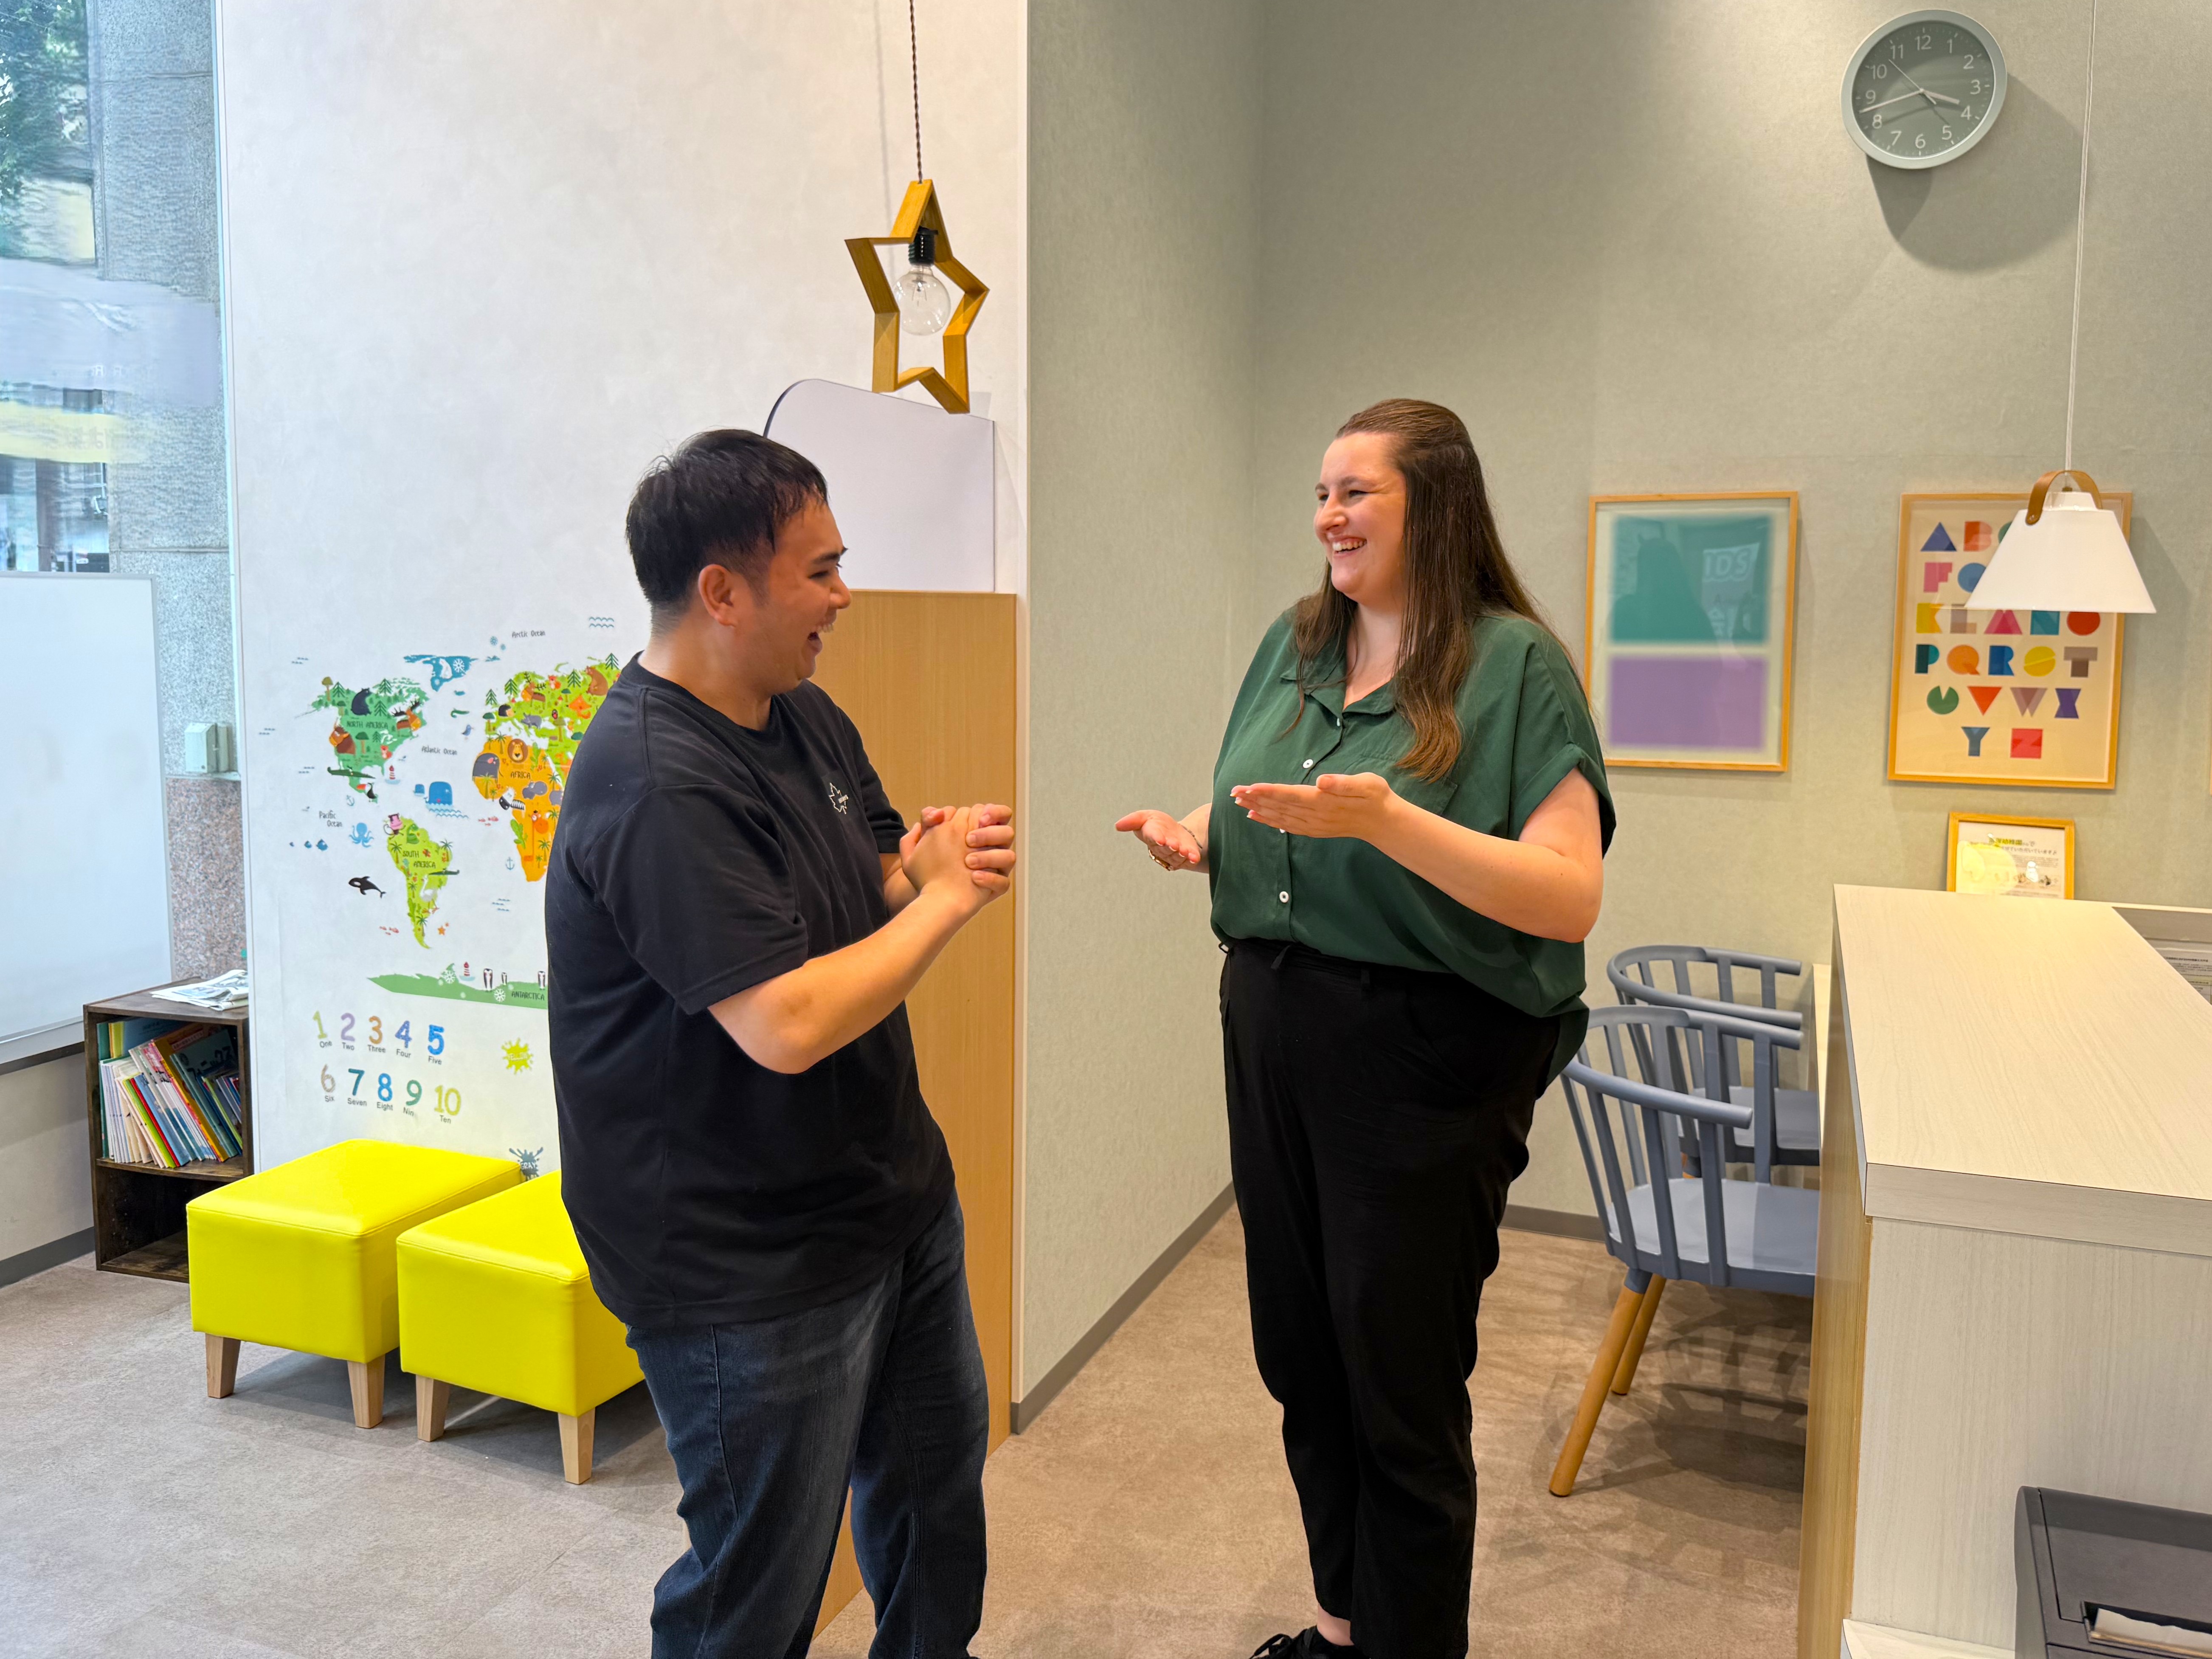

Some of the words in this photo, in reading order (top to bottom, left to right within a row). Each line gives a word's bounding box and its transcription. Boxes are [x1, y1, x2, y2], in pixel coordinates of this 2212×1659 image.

[1915, 35, 1931, 51] 12
[1947, 39, 1953, 53] 1
[1891, 44, 1903, 59] 11
[1964, 55, 1974, 69] 2
[1870, 65, 1887, 79] 10
[1970, 79, 1981, 95] 3
[1866, 90, 1876, 104] 9
[1961, 105, 1972, 120] 4
[1872, 114, 1883, 129] 8
[1891, 131, 1902, 145] 7
[1942, 125, 1952, 140] 5
[1915, 134, 1926, 148] 6
[366, 721, 388, 729] AMERICA
[422, 745, 440, 753] Atlantic
[511, 771, 531, 779] AFRICA
[319, 809, 336, 819] Pacific
[414, 860, 436, 869] AMERICA
[512, 991, 545, 1000] ANTARCTICA
[312, 1010, 327, 1039] 1
[341, 1013, 355, 1042] 2
[369, 1016, 383, 1044] 3
[395, 1020, 412, 1048] 4
[428, 1024, 445, 1055] 5
[319, 1040, 332, 1048] One
[342, 1042, 355, 1051] Two
[367, 1044, 386, 1053] Three
[396, 1049, 411, 1058] Four
[428, 1056, 442, 1065] Five
[321, 1064, 336, 1093] 6
[348, 1068, 365, 1096] 7
[377, 1073, 393, 1101] 8
[405, 1079, 422, 1106] 9
[325, 1095, 335, 1103] Six
[347, 1098, 367, 1107] Seven
[377, 1101, 393, 1111] Eight
[434, 1084, 461, 1116] 10
[439, 1115, 451, 1124] Ten
